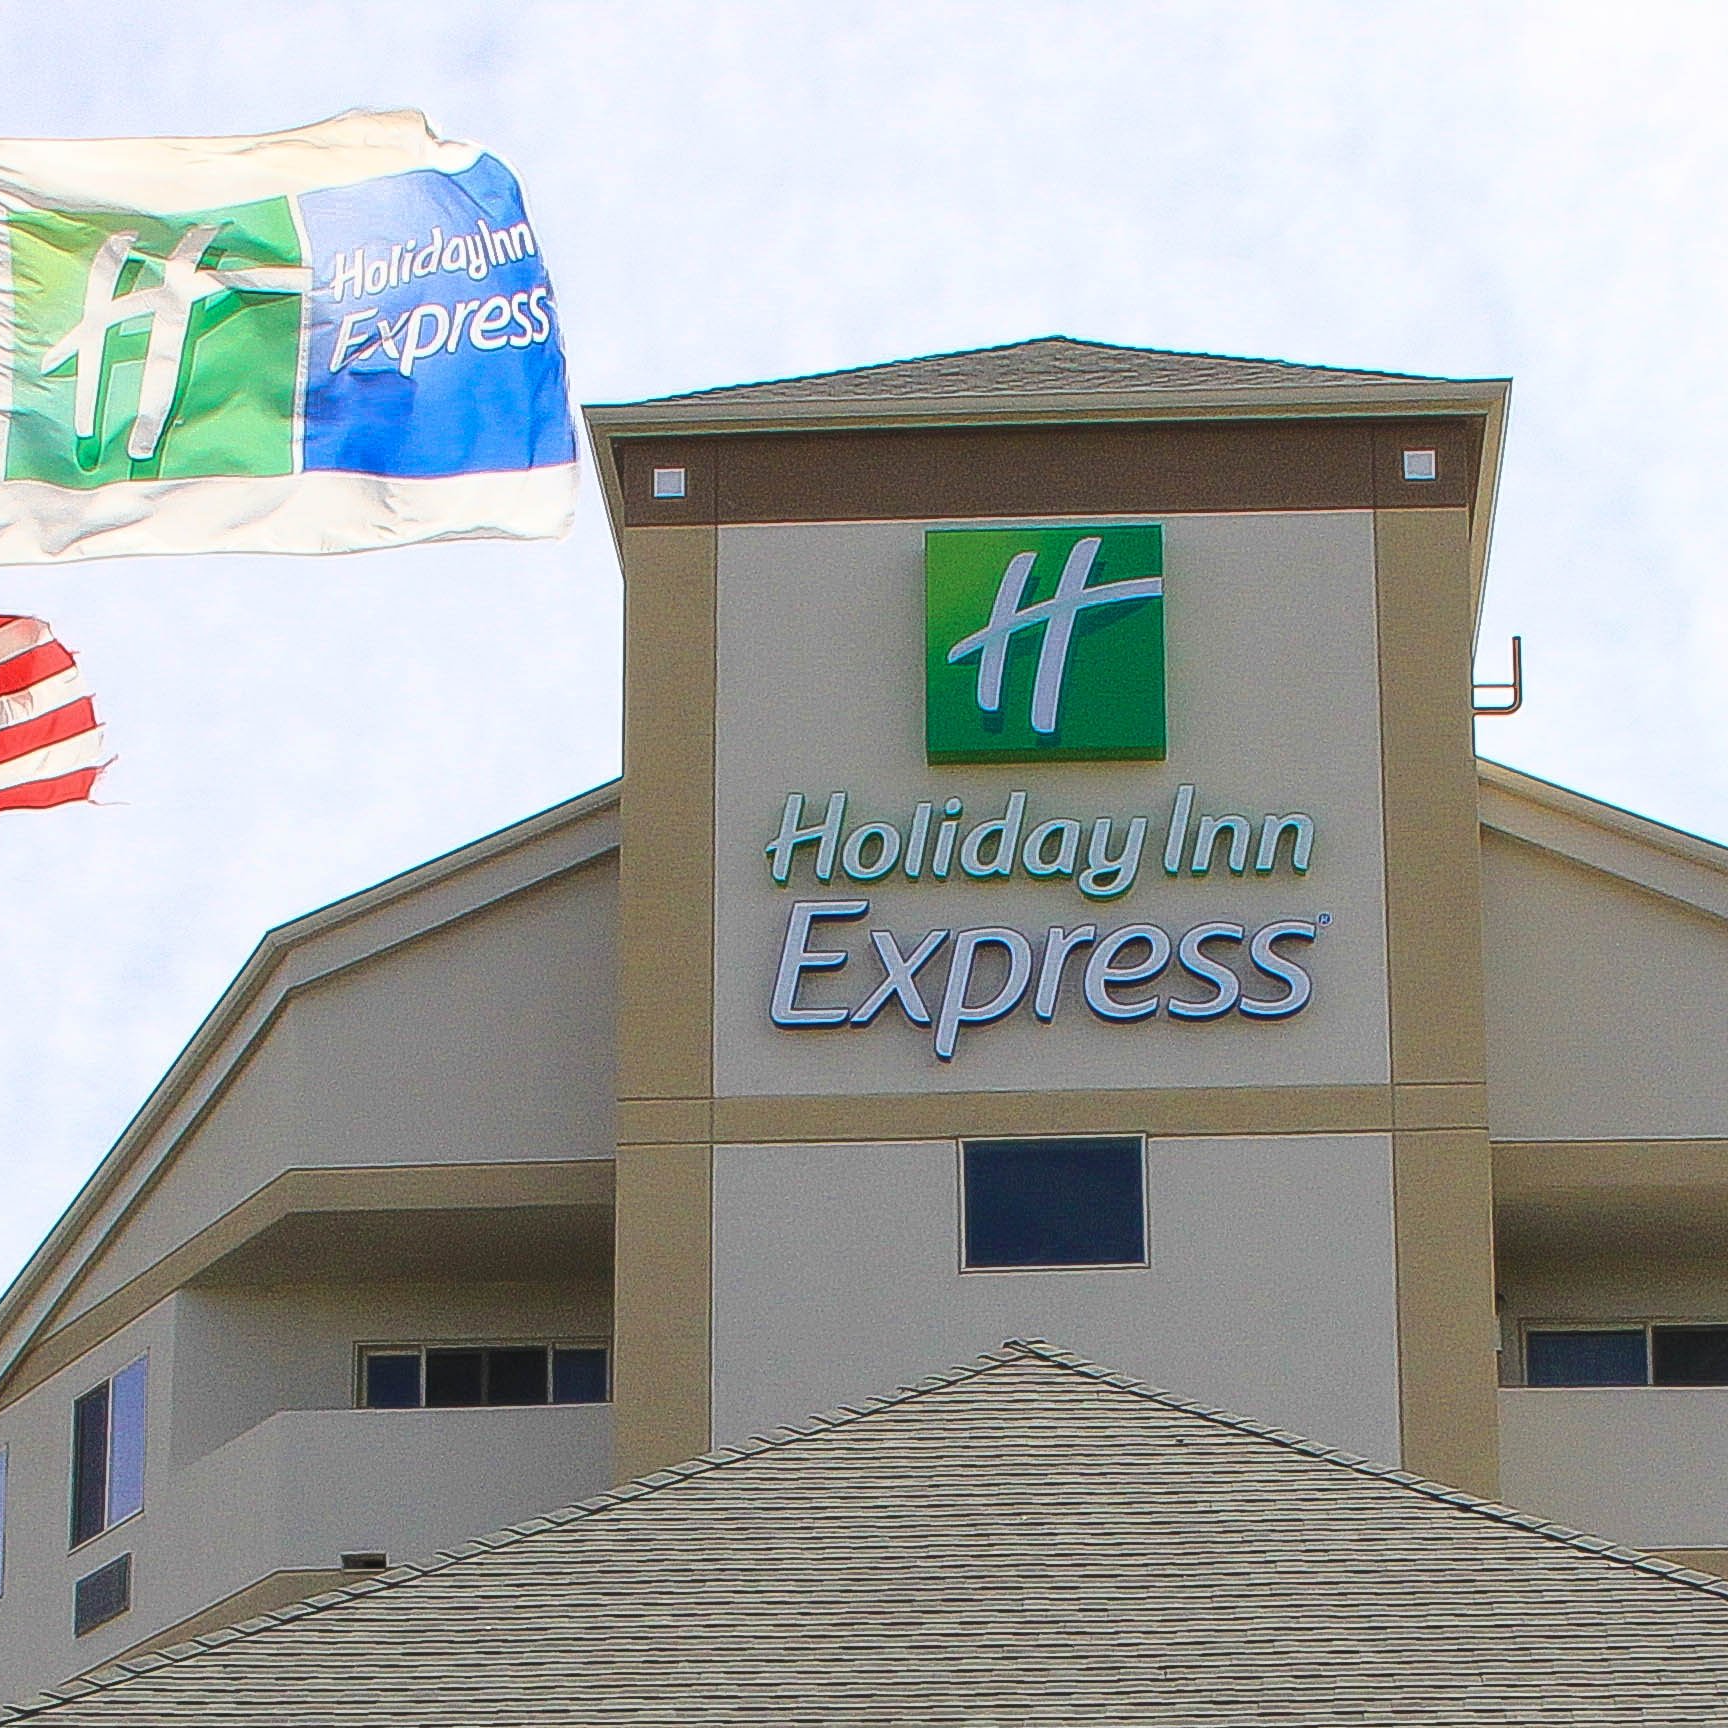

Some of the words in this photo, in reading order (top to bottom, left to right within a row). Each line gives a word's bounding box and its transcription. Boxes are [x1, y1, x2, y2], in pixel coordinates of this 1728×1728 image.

[330, 226, 488, 303] Holiday
[477, 218, 537, 267] Inn
[328, 285, 551, 377] Express
[766, 790, 1148, 897] Holiday
[1163, 784, 1315, 878] Inn
[771, 899, 1317, 1062] Express
